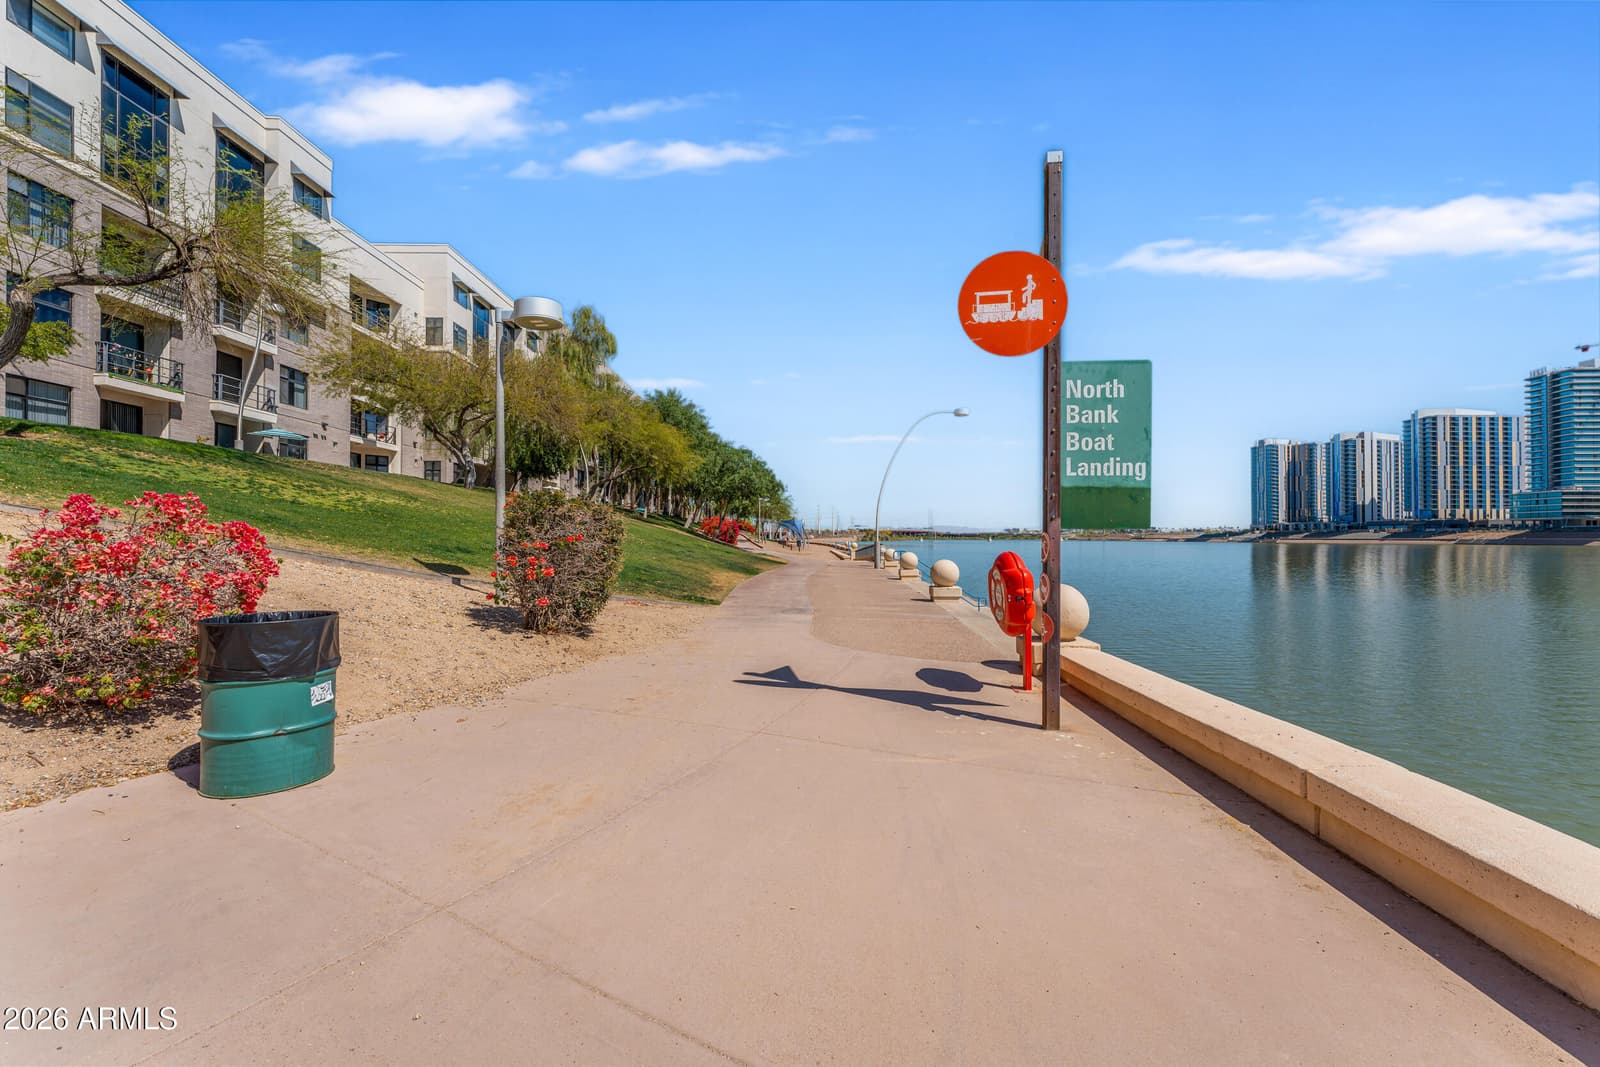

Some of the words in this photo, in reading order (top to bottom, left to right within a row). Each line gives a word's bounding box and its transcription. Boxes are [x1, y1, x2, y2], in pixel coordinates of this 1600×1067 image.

[1066, 379, 1125, 399] North
[1066, 404, 1119, 424] Bank
[1066, 431, 1115, 451] Boat
[1065, 457, 1147, 481] Landing
